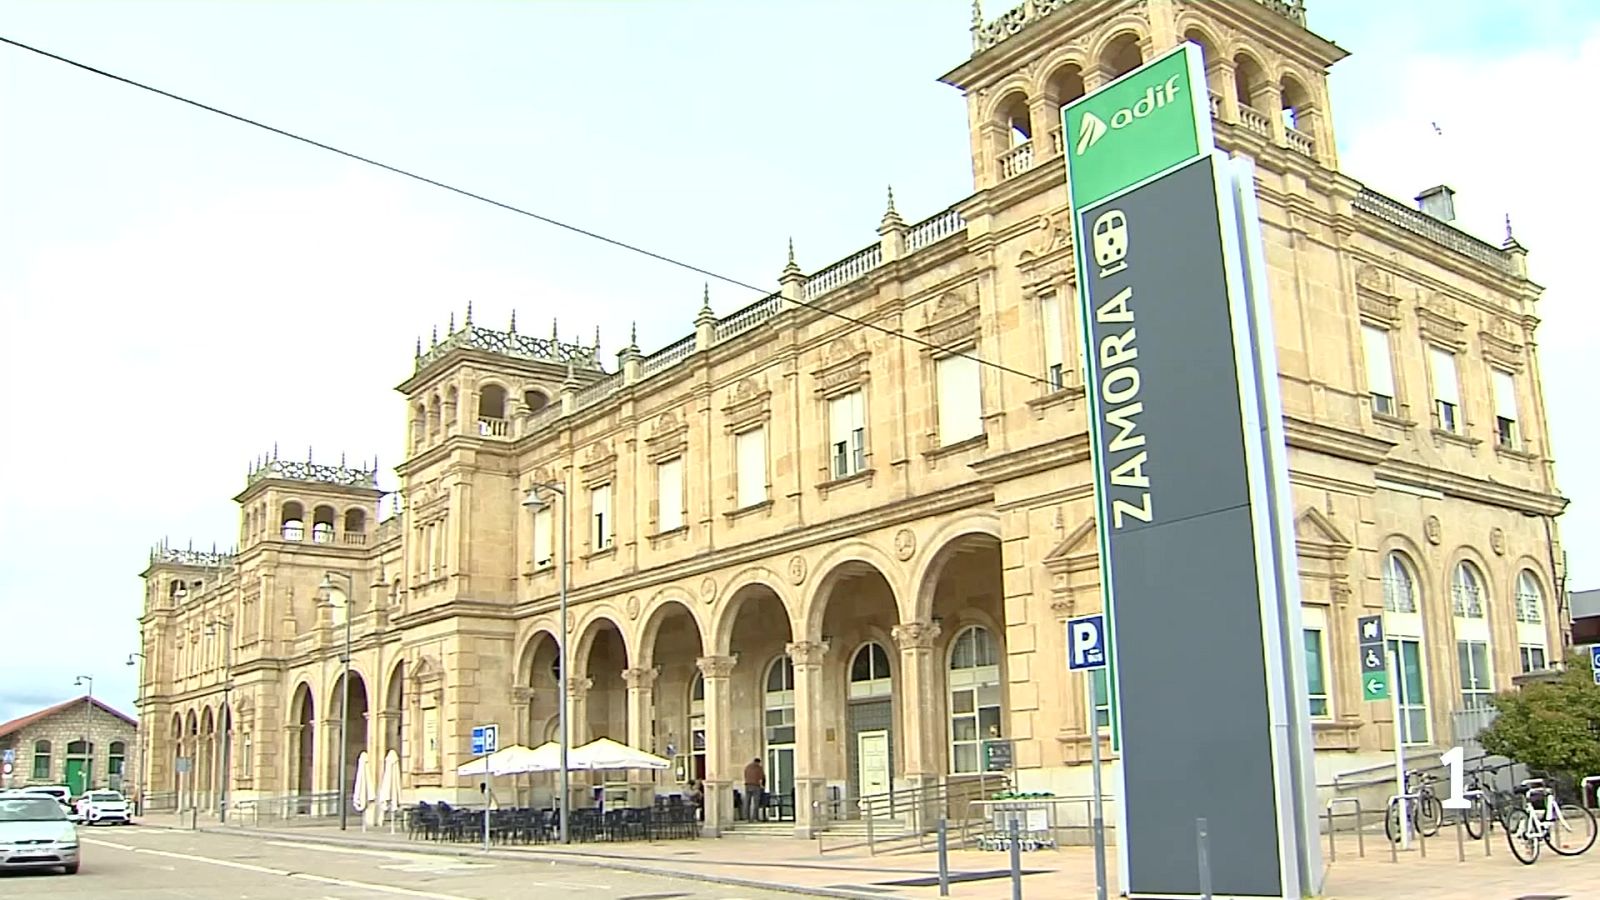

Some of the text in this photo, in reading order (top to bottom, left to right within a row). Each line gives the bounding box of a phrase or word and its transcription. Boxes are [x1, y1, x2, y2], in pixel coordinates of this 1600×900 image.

[1110, 73, 1181, 130] adif
[1096, 286, 1153, 529] ZAMORA
[1073, 622, 1098, 665] P
